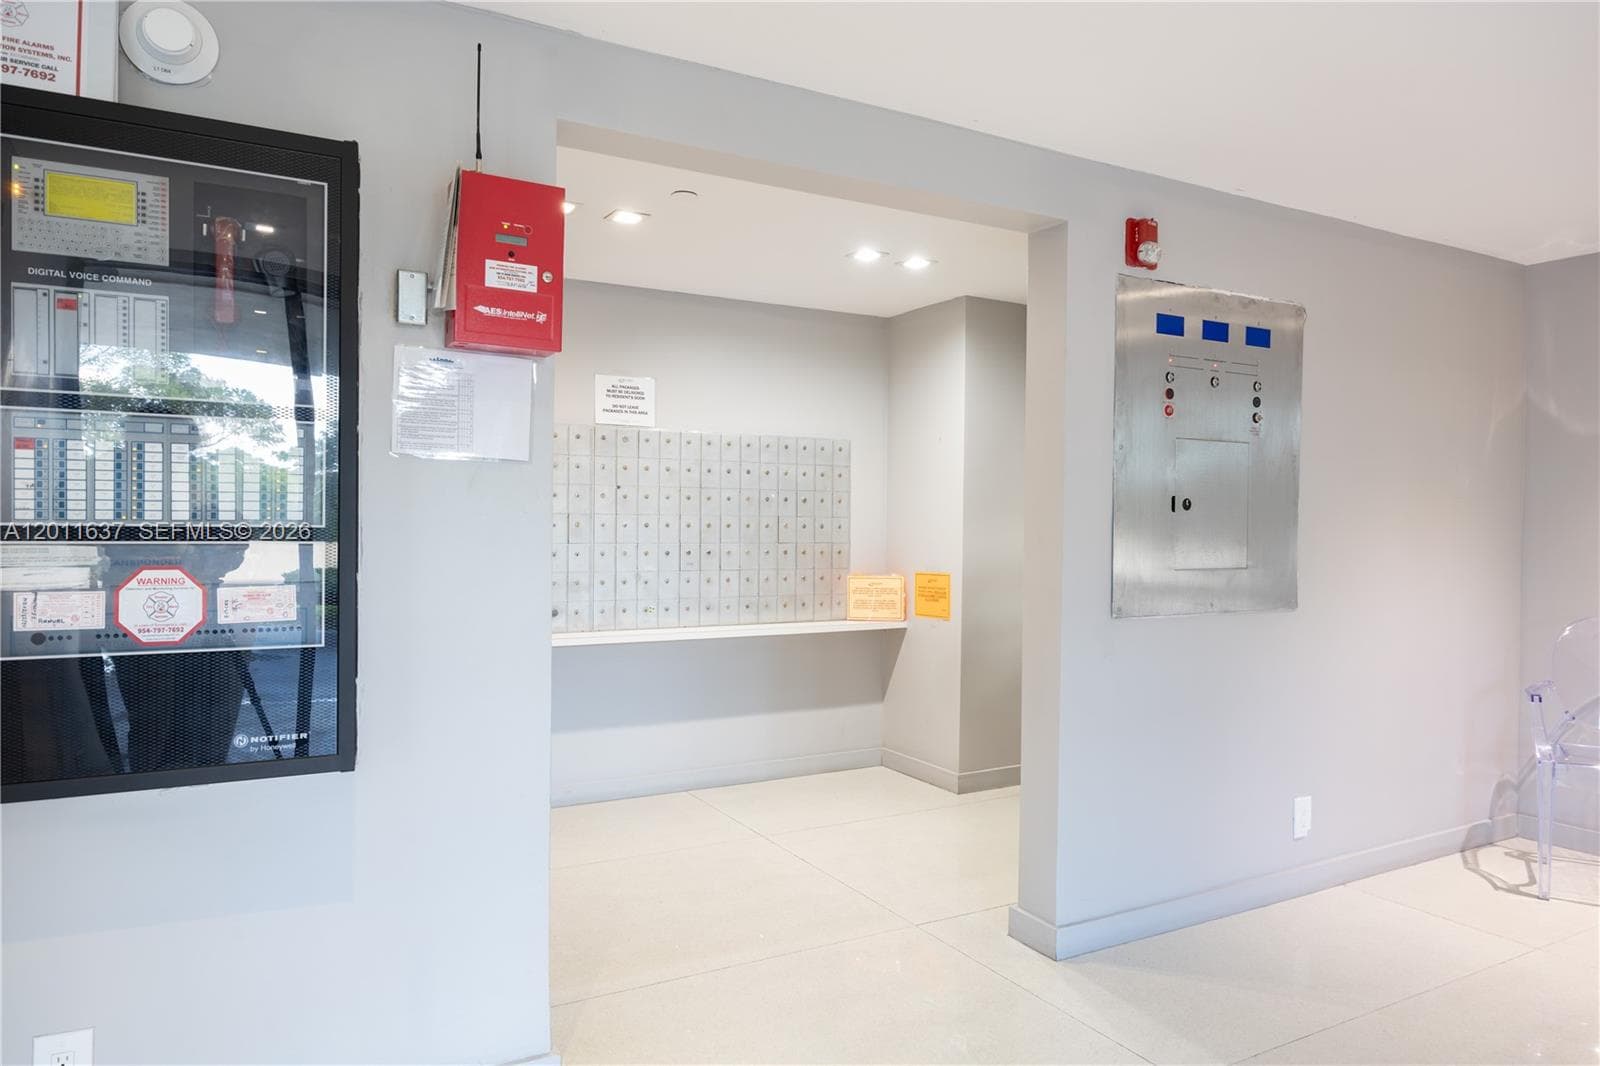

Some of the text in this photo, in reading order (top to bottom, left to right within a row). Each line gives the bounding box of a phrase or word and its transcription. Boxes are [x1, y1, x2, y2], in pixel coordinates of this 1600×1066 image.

[2, 35, 54, 51] FIRE ALARMS
[18, 47, 55, 60] SYSTEMS,
[57, 54, 72, 62] INC.
[9, 58, 40, 68] SERVICE
[41, 64, 59, 72] CALL
[1, 64, 56, 82] 97-7692
[27, 266, 152, 287] DIGITAL VOICE COMMAND
[485, 307, 502, 315] AES
[136, 577, 186, 585] WARNING
[137, 626, 185, 634] 954-797-7692
[250, 733, 308, 743] NOTIFIER
